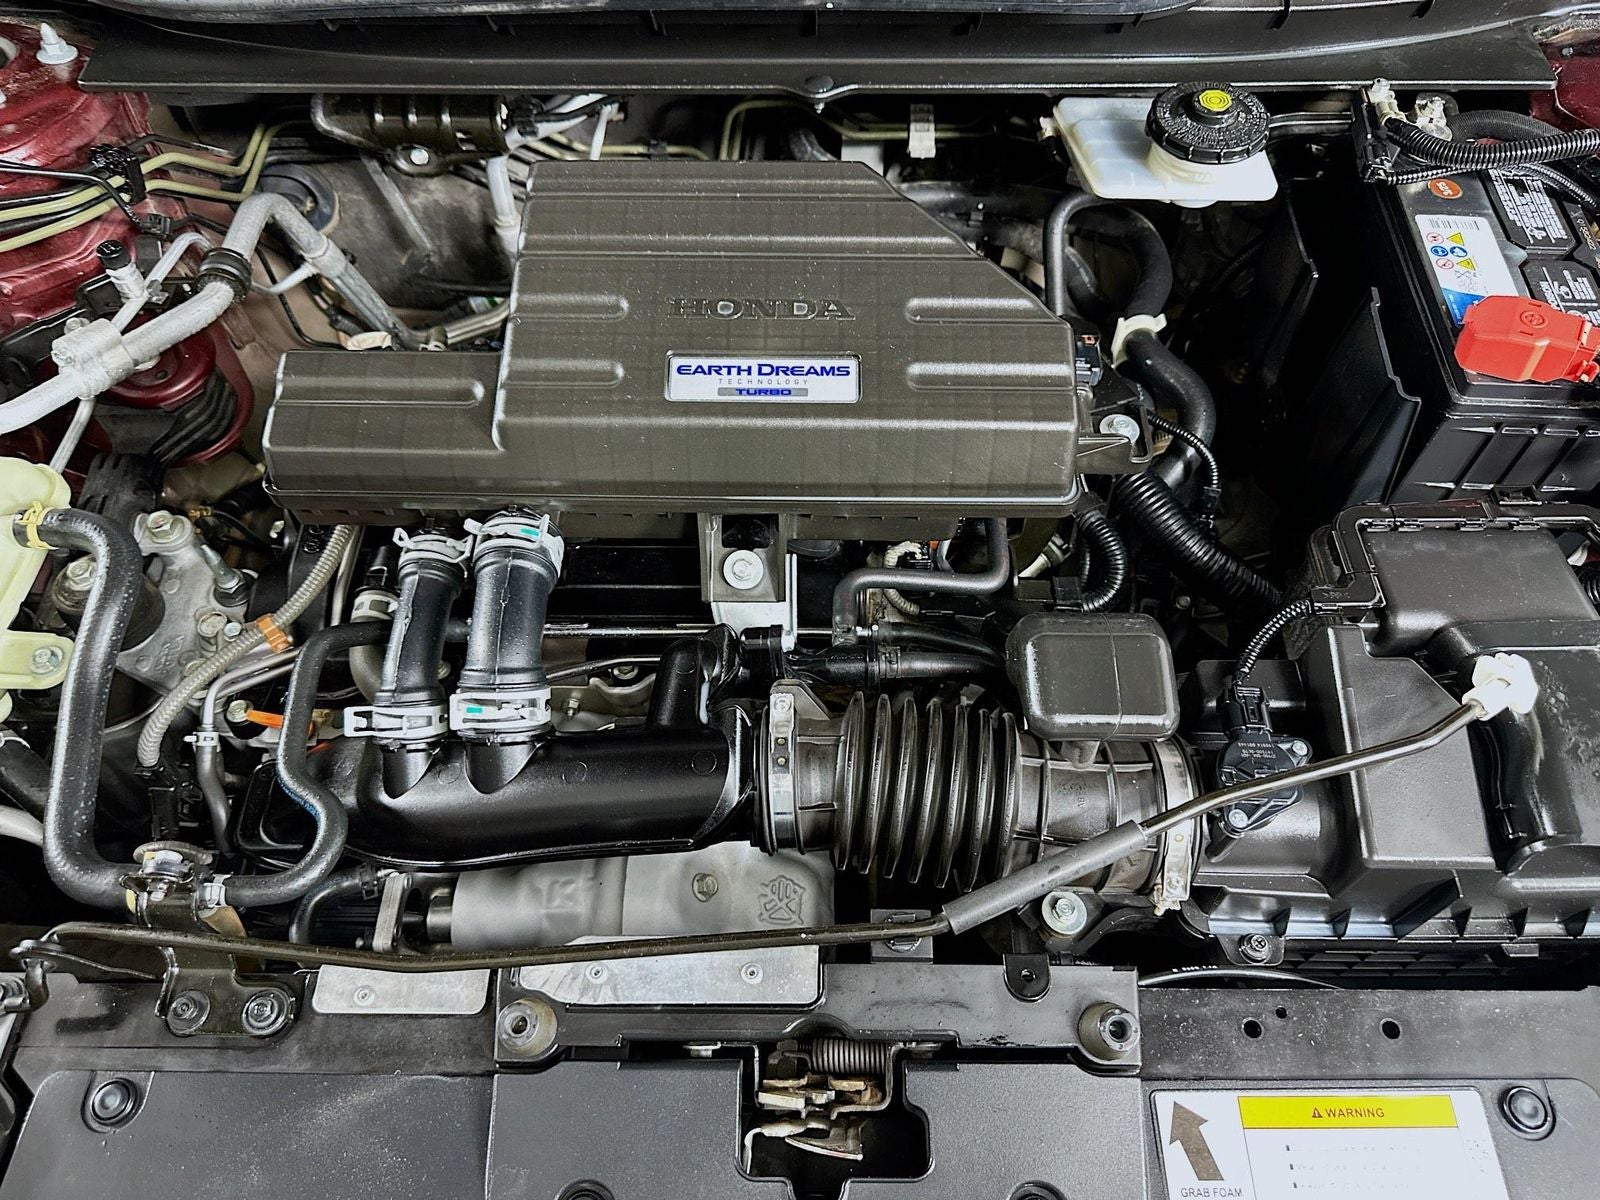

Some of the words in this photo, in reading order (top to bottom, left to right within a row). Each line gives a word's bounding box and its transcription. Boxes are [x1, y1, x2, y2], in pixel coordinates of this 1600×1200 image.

[668, 299, 856, 321] HONDA
[676, 364, 752, 376] EARTH
[757, 363, 851, 377] DREAMS
[735, 388, 792, 396] TURBO
[1325, 1107, 1385, 1118] WARNING
[1180, 1187, 1211, 1198] GRAB
[1213, 1187, 1242, 1198] FOAM
